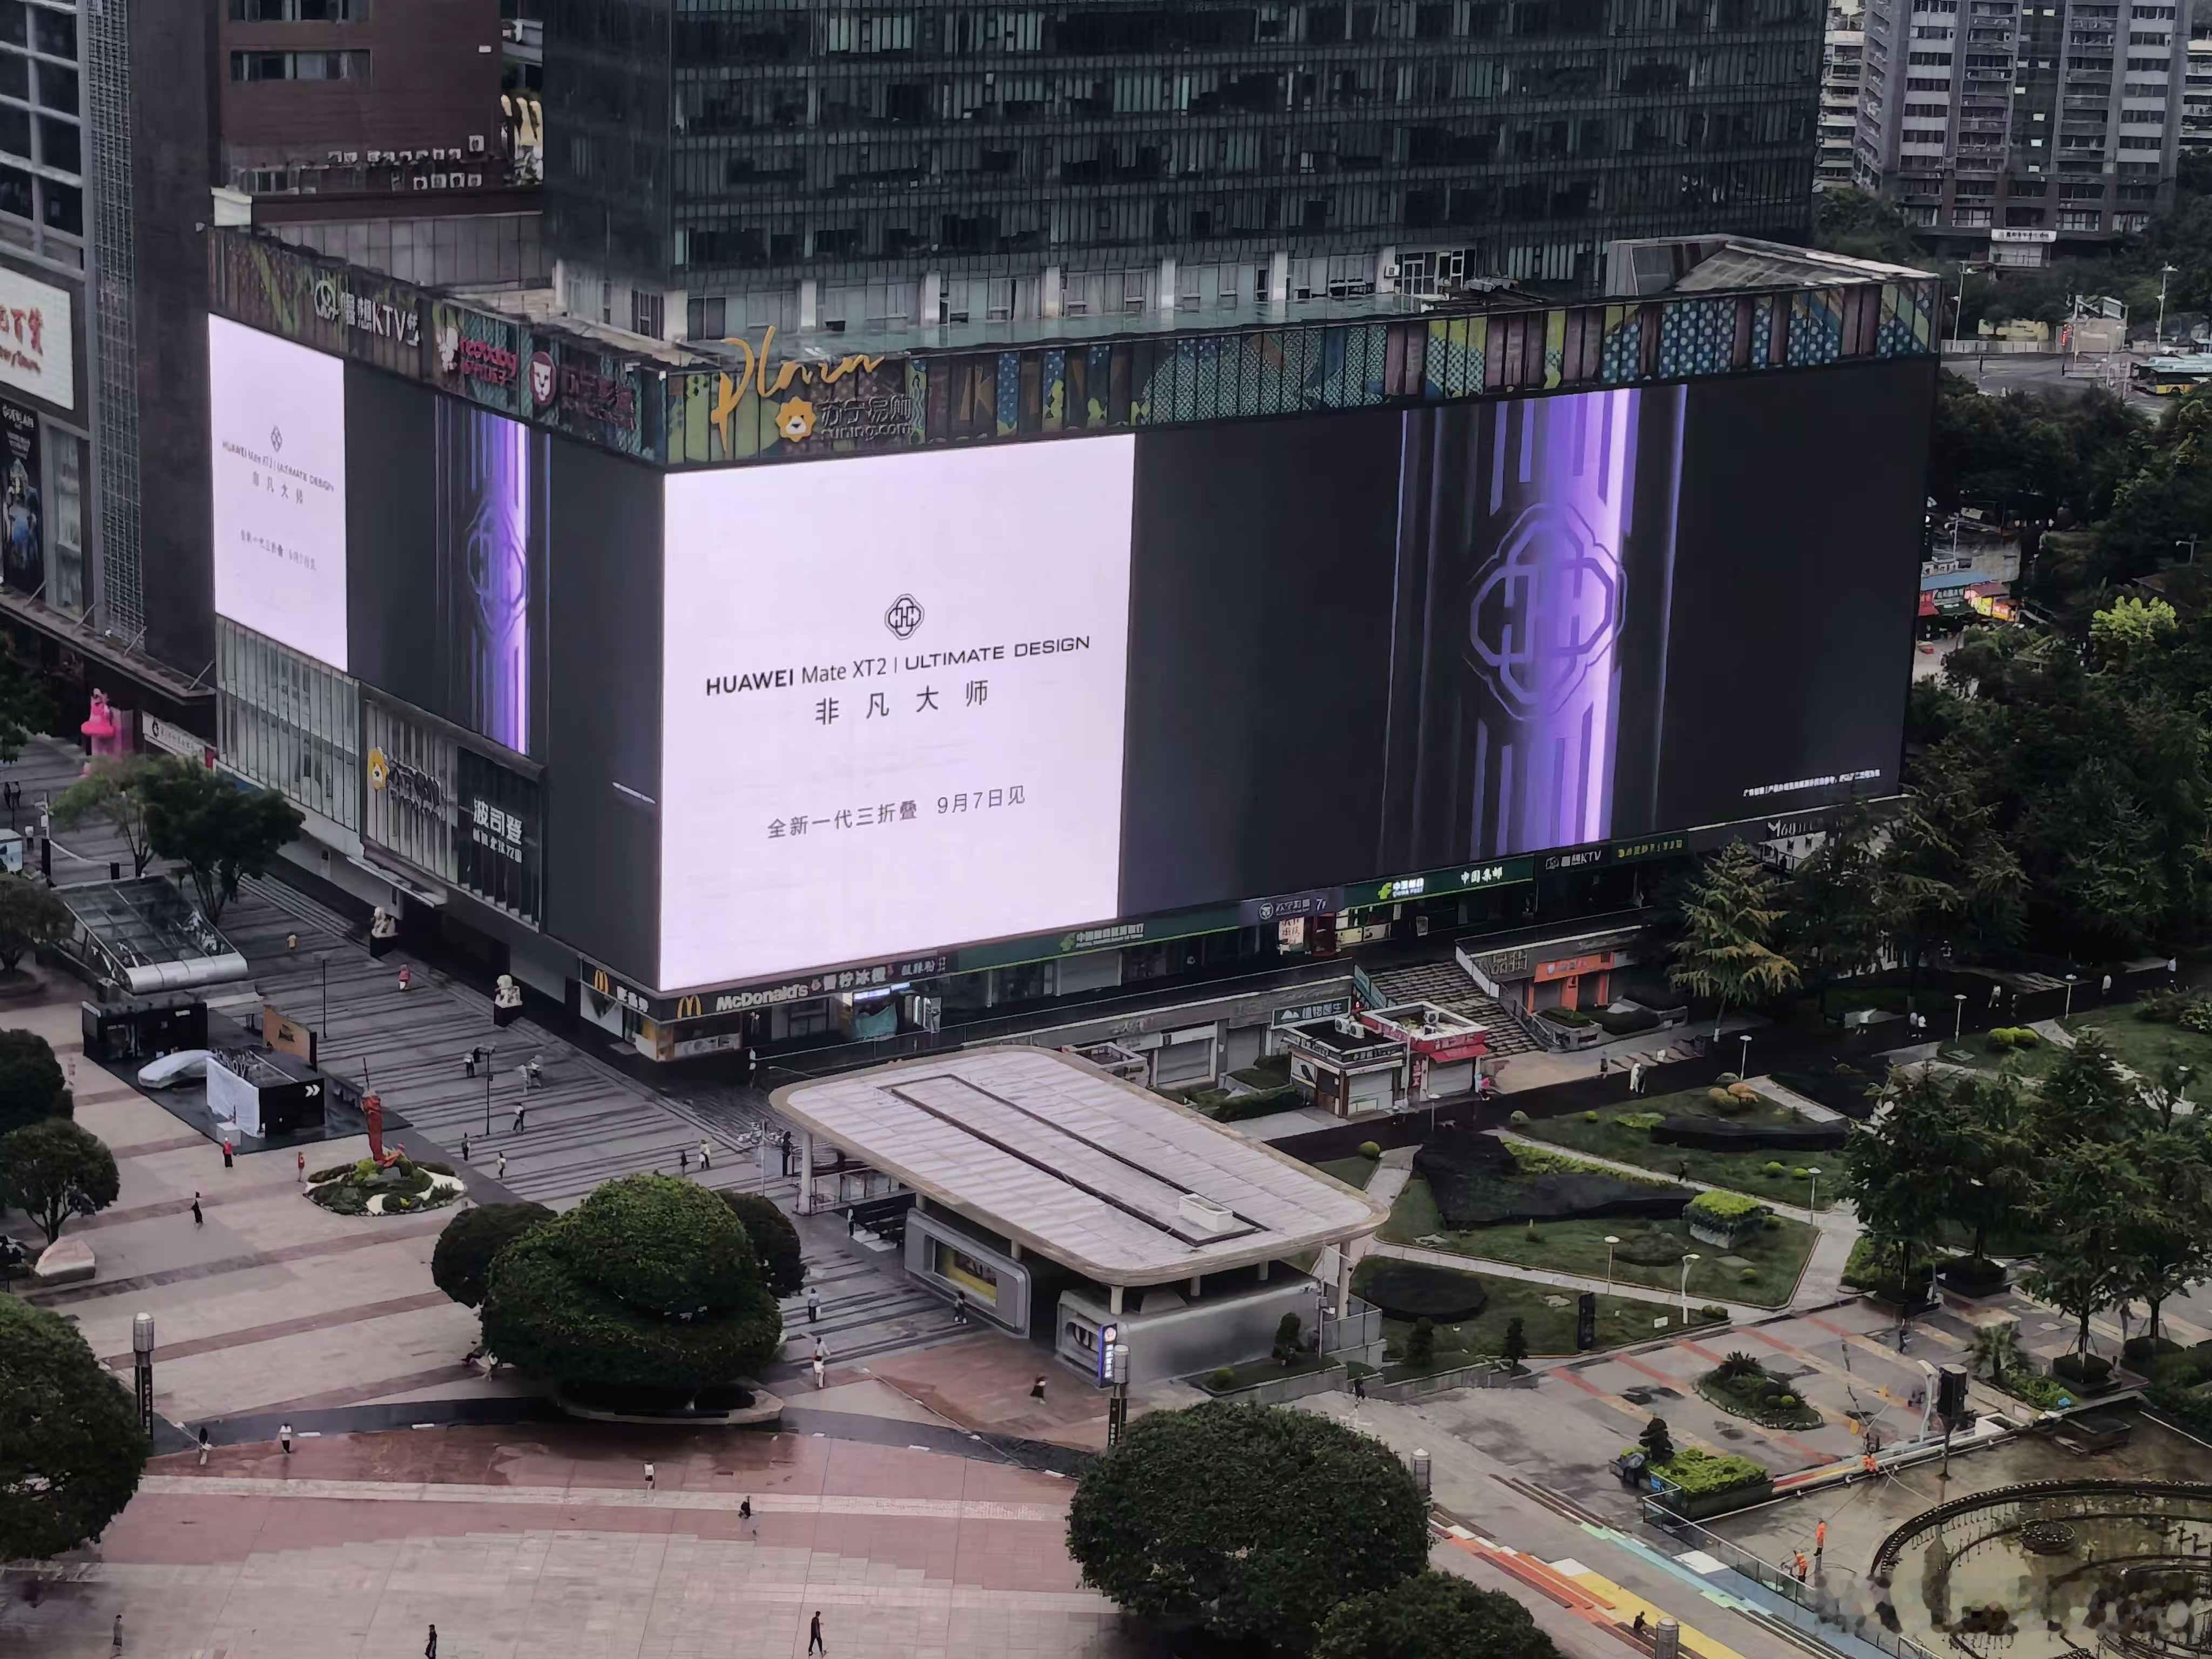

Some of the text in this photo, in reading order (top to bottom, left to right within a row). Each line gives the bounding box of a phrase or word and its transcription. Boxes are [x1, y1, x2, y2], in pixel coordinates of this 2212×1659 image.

[706, 635, 1090, 696] HUAWEI Mate XT2 ULTIMATE DESIGN
[815, 679, 989, 725] 非凡大师
[474, 797, 522, 845] 波司登
[767, 785, 1026, 839] 全新一代三折叠 9月7日见
[716, 983, 808, 1012] McDonald's
